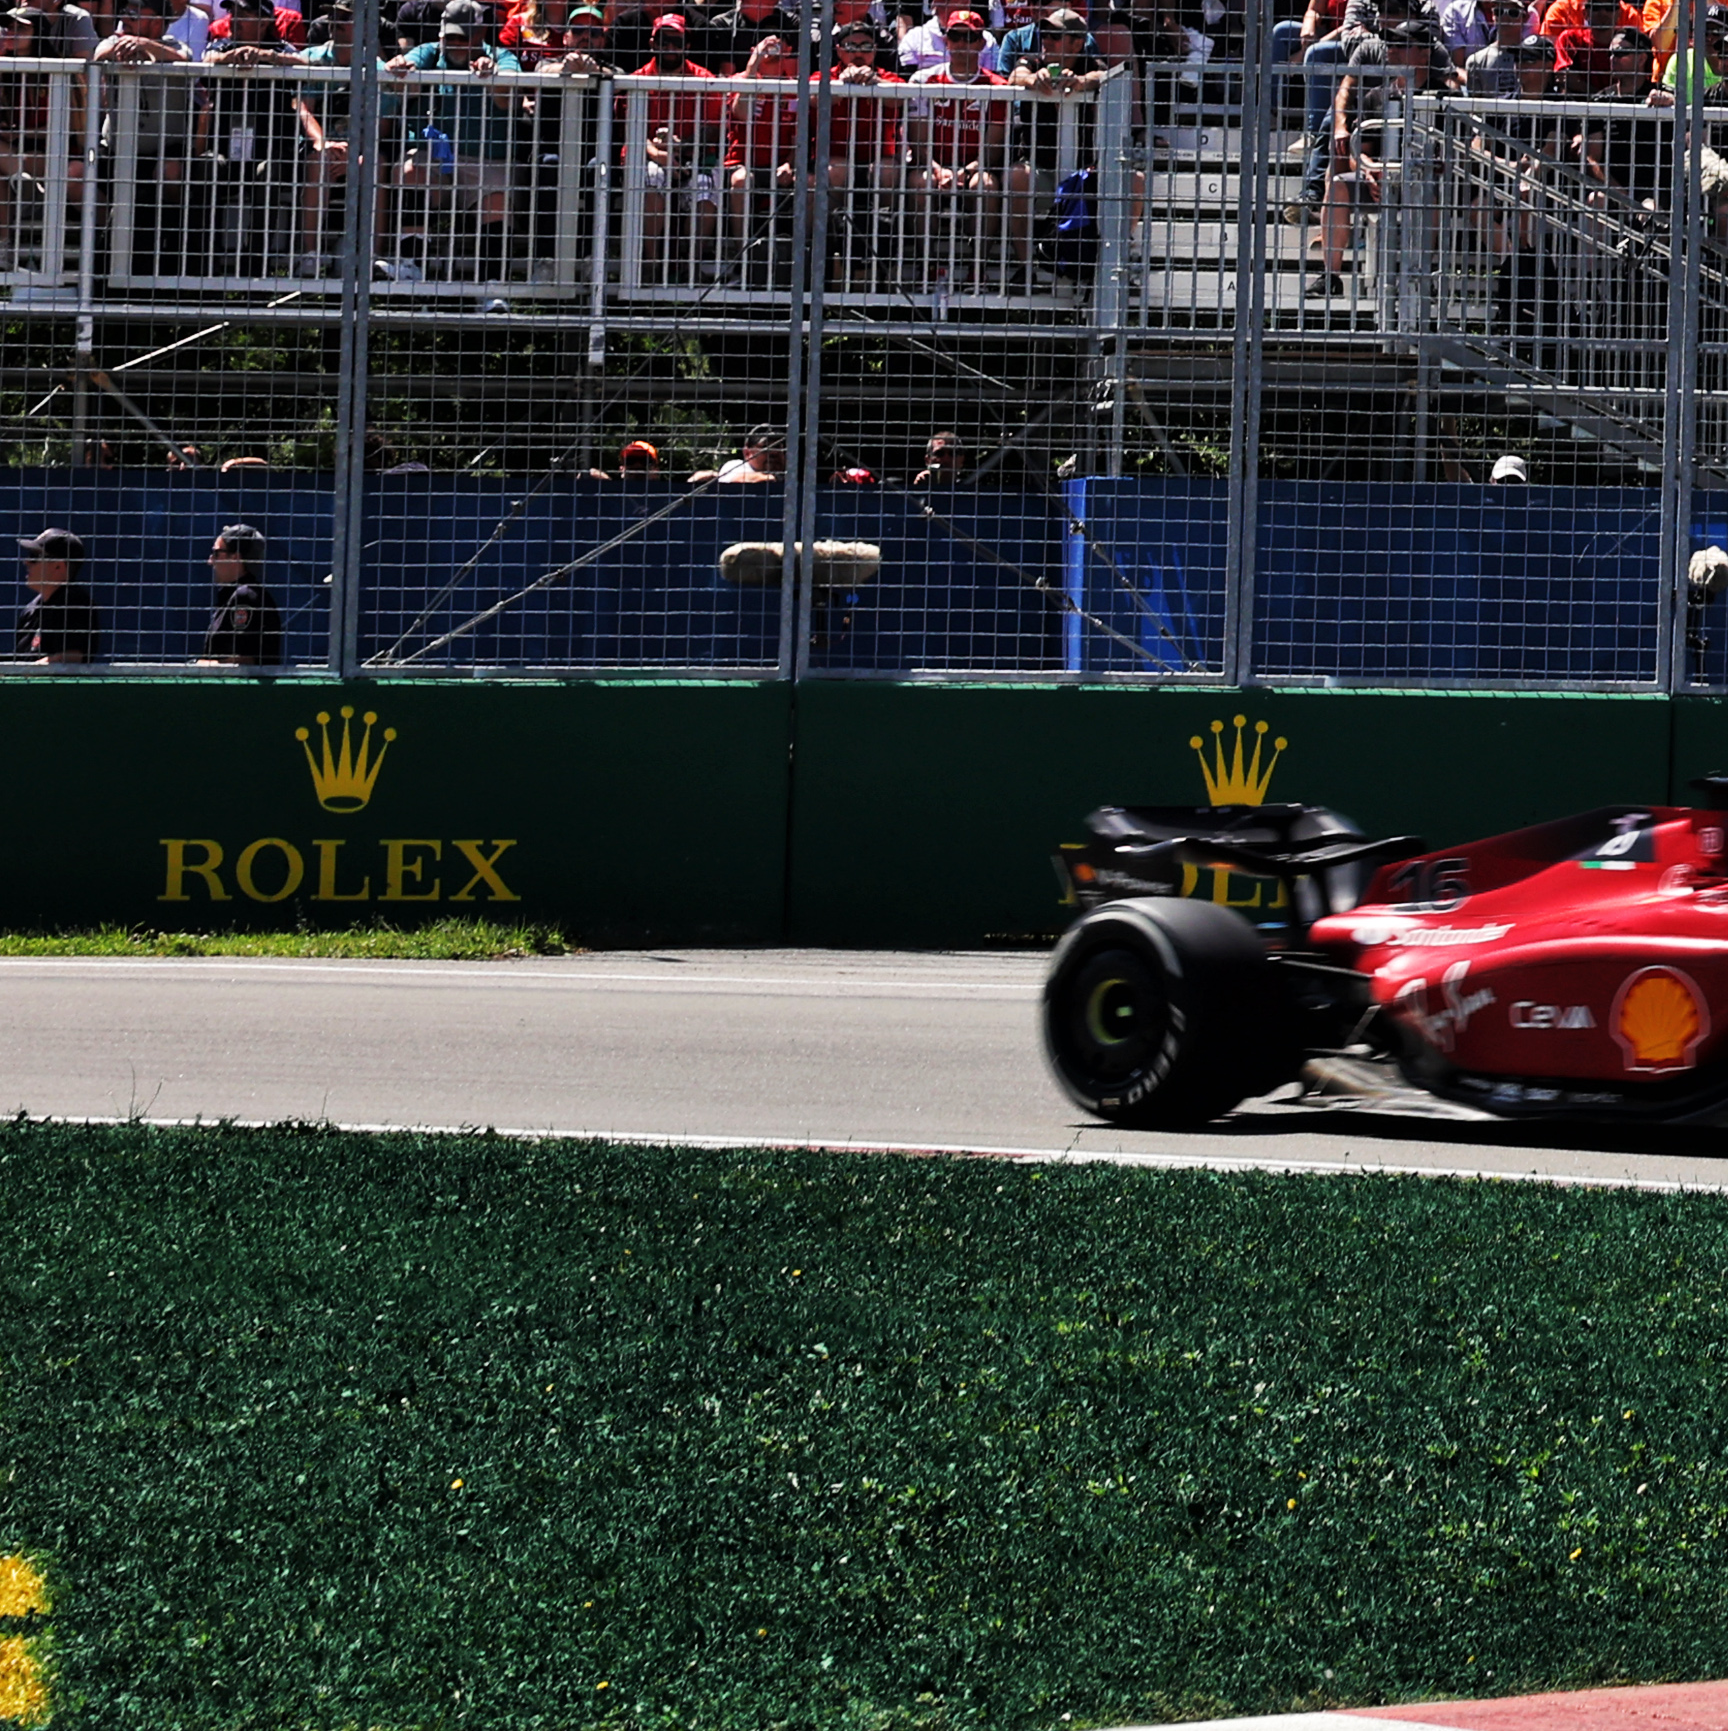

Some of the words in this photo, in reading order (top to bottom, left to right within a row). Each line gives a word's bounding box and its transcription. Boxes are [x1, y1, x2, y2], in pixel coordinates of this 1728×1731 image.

[1208, 183, 1217, 193] C
[1227, 281, 1236, 291] A
[156, 838, 522, 903] ROLEX
